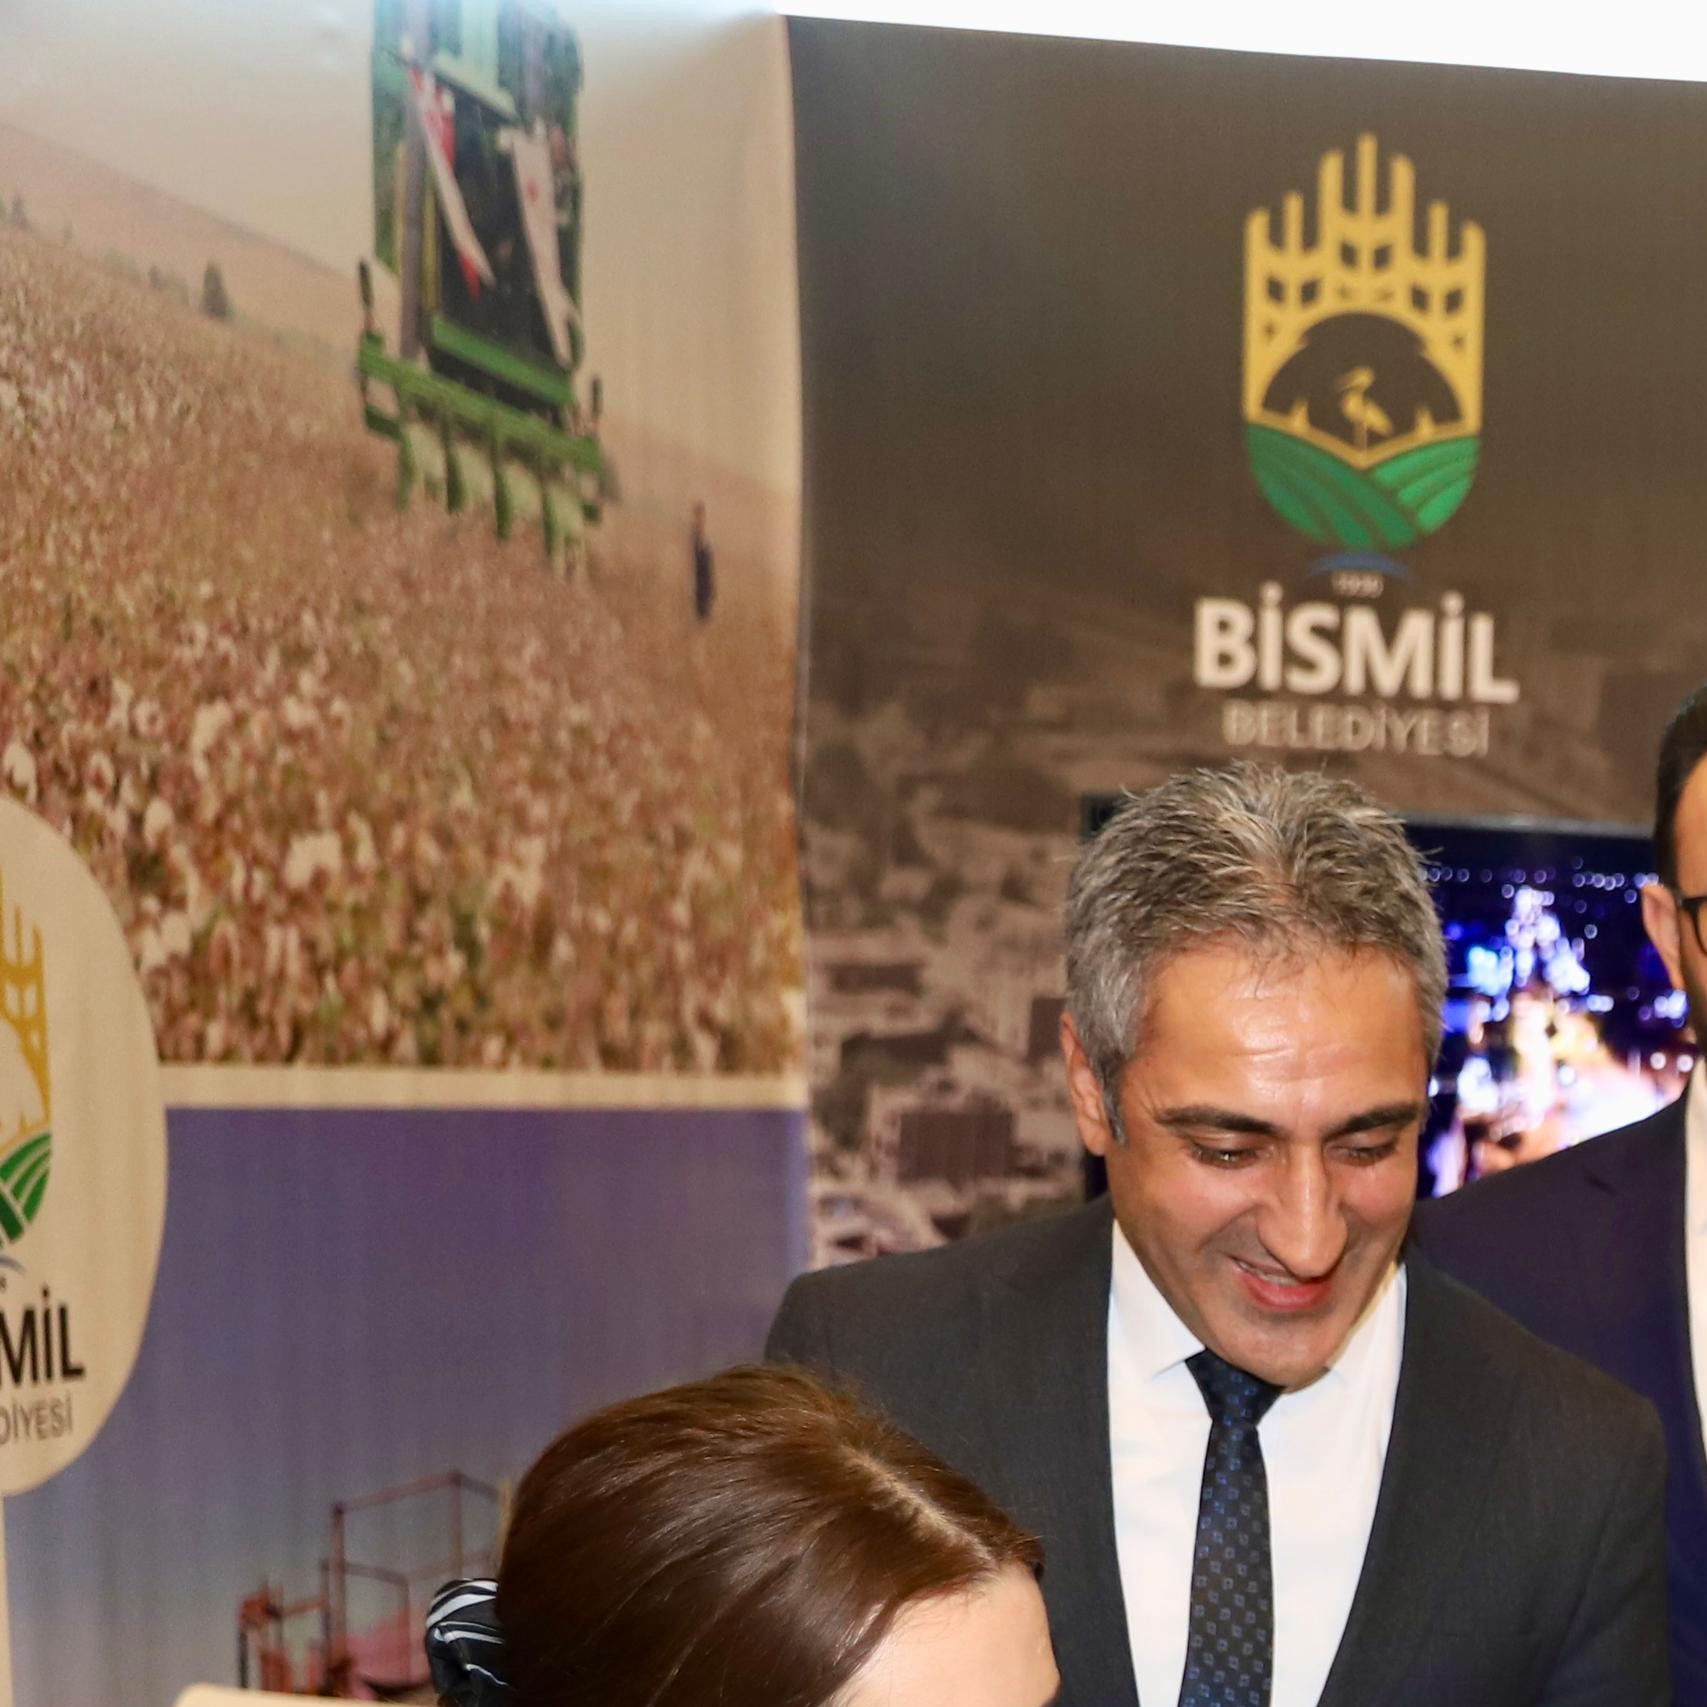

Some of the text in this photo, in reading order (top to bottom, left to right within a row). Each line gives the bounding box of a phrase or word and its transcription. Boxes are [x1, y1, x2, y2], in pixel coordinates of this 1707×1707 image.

[1193, 579, 1520, 704] BİSMİL
[0, 1283, 86, 1390] MİL
[0, 1389, 74, 1445] DİYESİ
